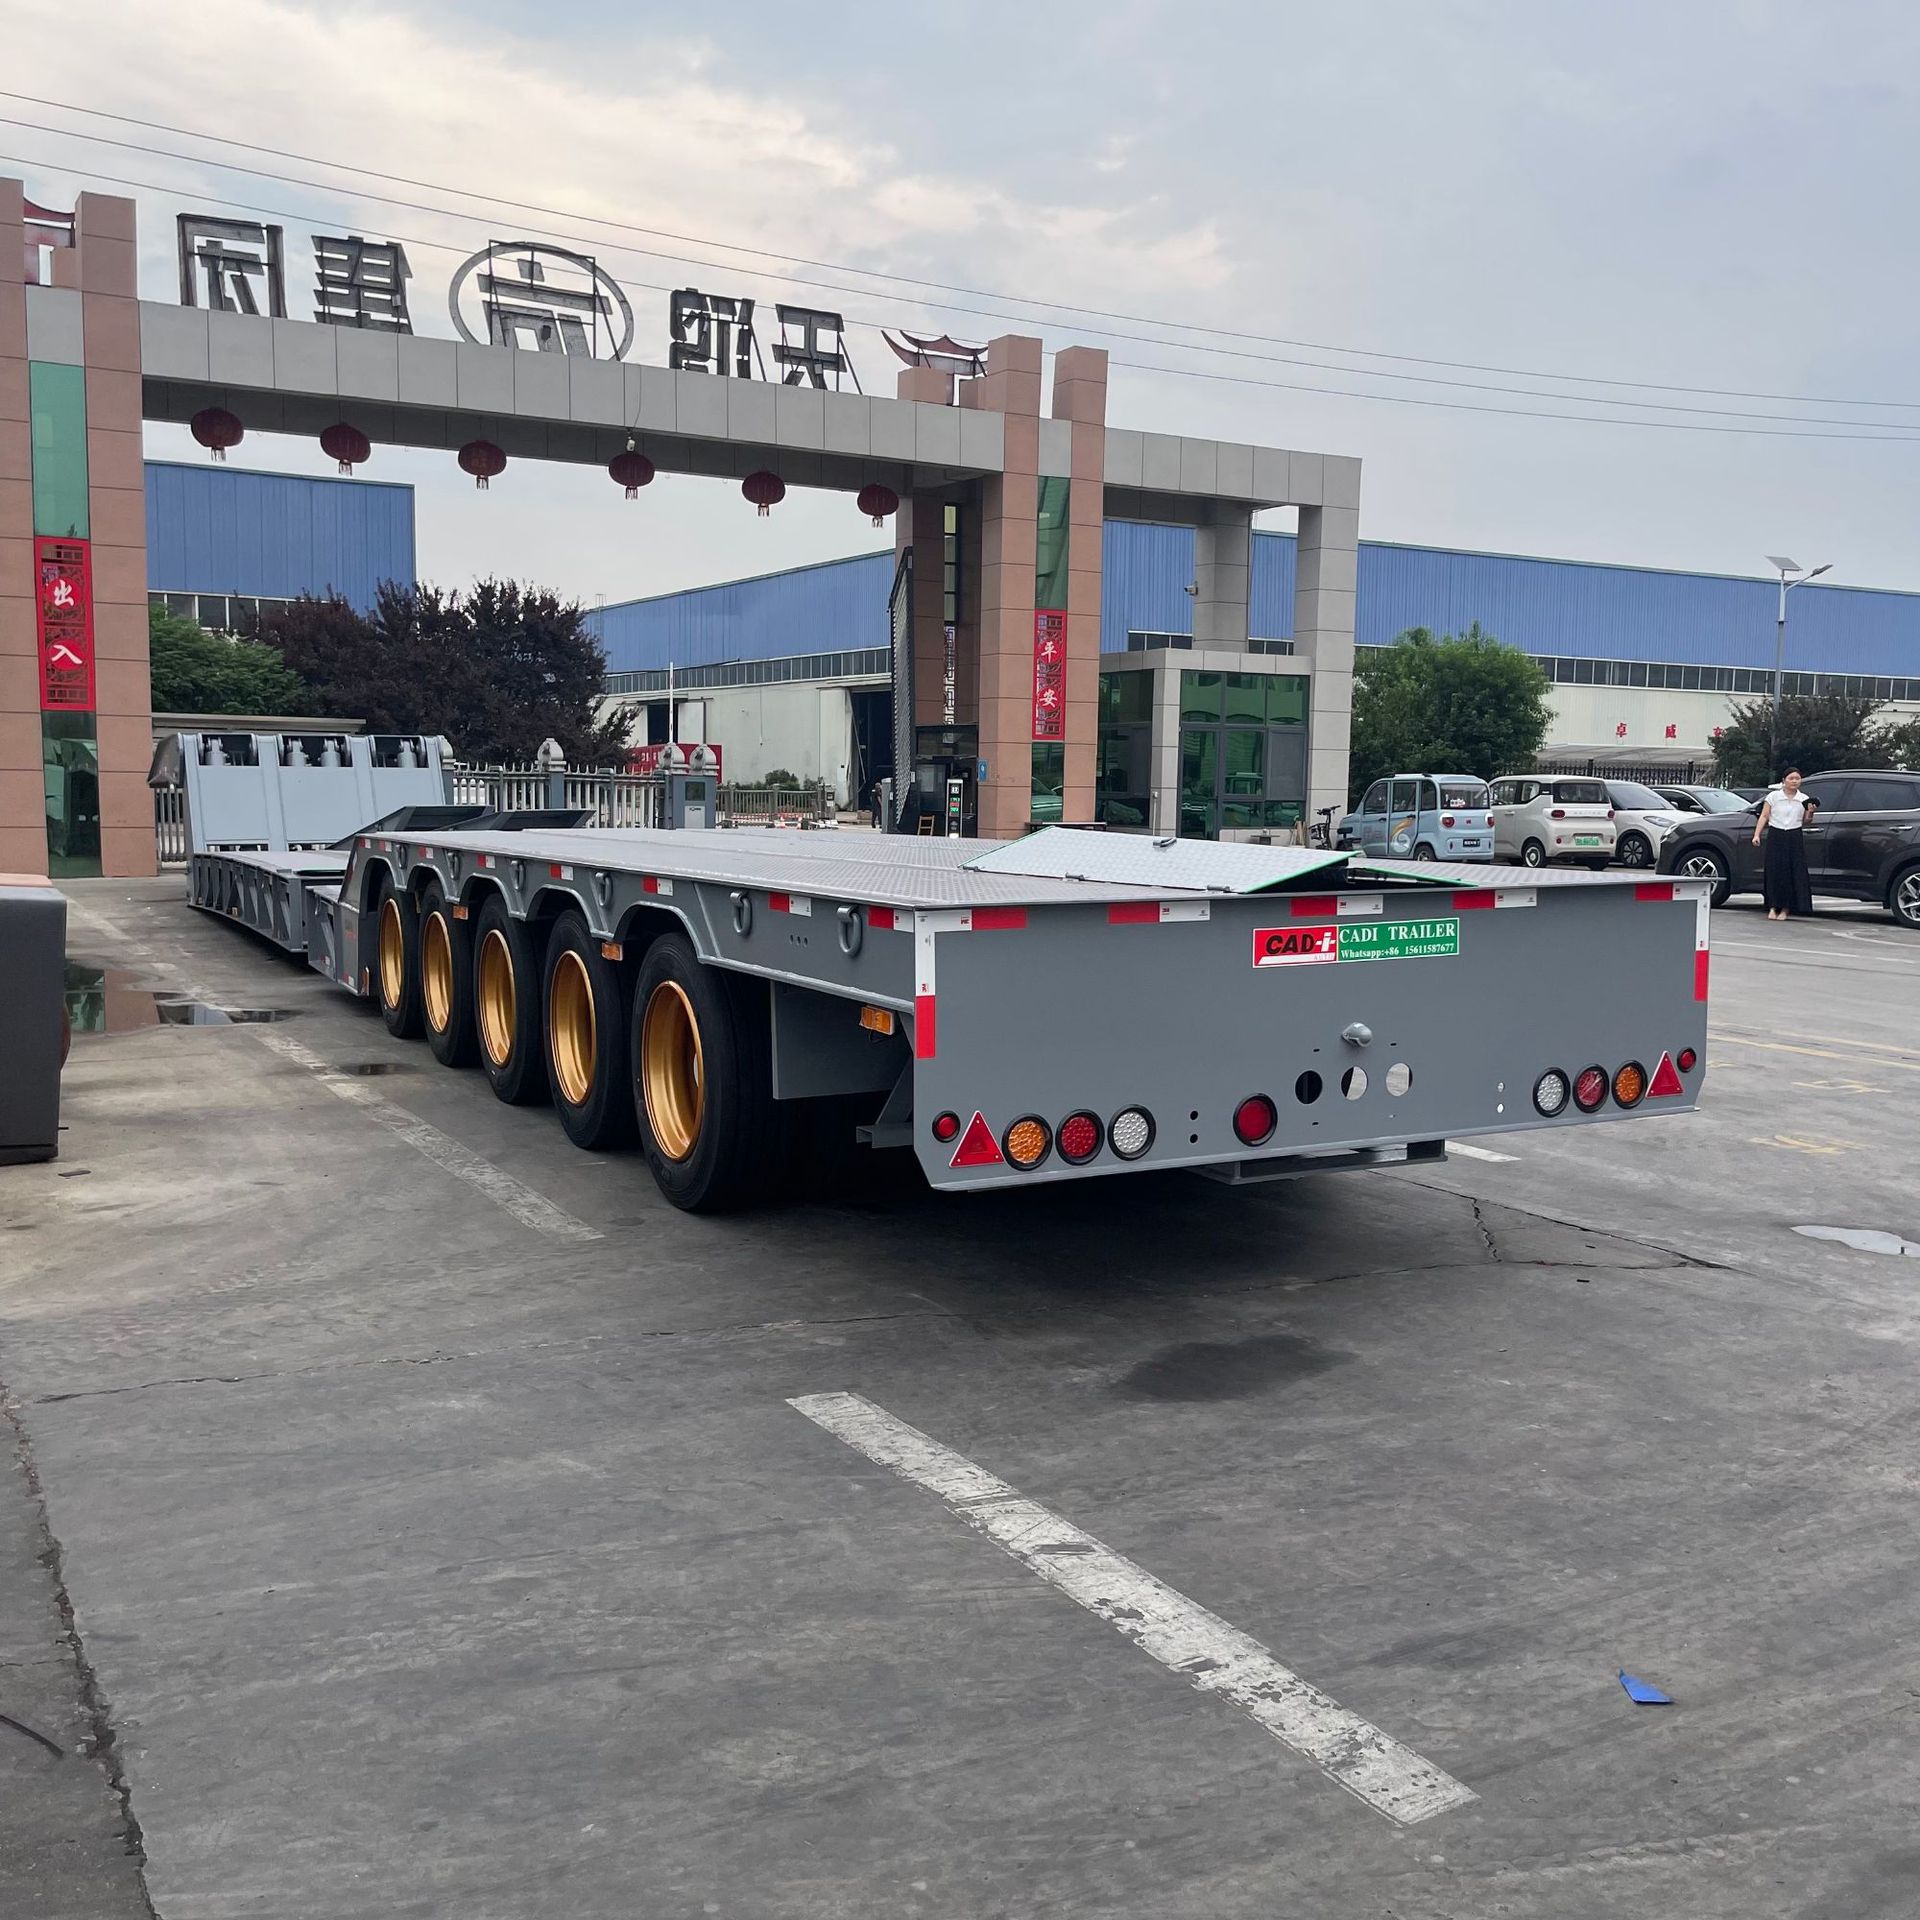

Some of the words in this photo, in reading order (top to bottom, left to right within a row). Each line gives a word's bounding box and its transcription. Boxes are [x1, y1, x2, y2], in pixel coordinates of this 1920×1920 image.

[52, 579, 83, 665] 出入
[1040, 641, 1058, 708] 平安
[1339, 927, 1378, 943] CADI
[1388, 923, 1455, 941] TRAILER
